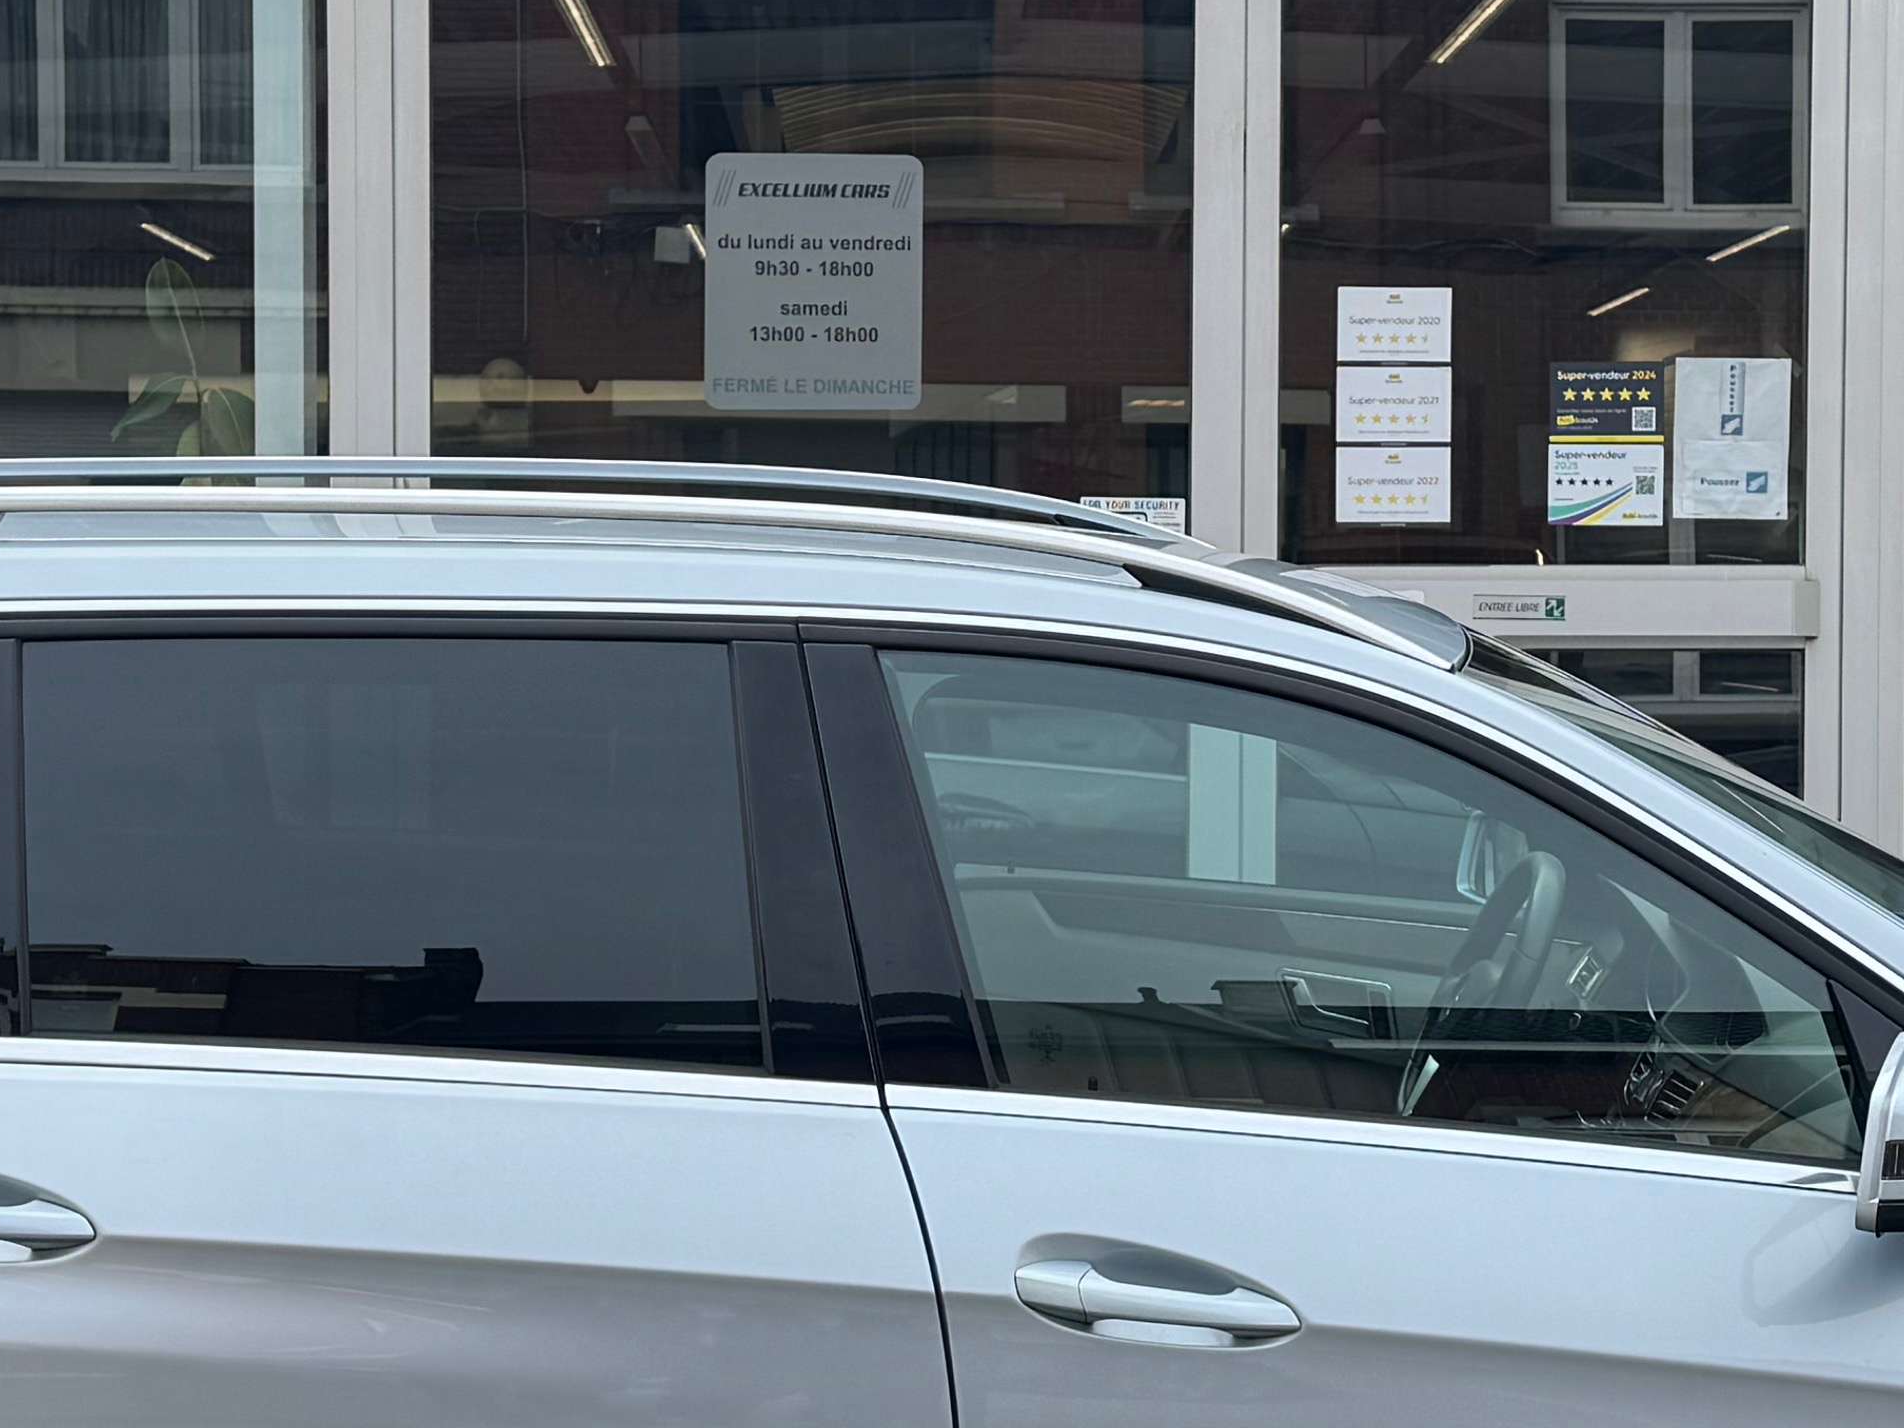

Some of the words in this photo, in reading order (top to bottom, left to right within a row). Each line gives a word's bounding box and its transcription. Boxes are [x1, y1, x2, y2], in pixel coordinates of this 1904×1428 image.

[738, 182, 838, 199] EXCELLIUM
[840, 183, 891, 200] CARS
[718, 234, 741, 251] du
[747, 233, 795, 251] lundi
[801, 237, 823, 251] au
[830, 234, 912, 252] vendredi
[754, 260, 801, 277] 9h30
[818, 260, 874, 278] 18h00
[780, 300, 849, 317] samedi
[750, 326, 805, 343] 13h00
[824, 326, 879, 343] 18h00
[1557, 370, 1630, 382] Super-vendeur
[712, 375, 778, 395] FERMÉ
[784, 378, 808, 395] LE
[813, 378, 915, 396] DIMANCHE
[1554, 449, 1628, 461] Super-vendeur
[1700, 476, 1740, 486] Pousser
[1134, 500, 1180, 511] SECURITY
[1515, 602, 1541, 613] LIBRE
